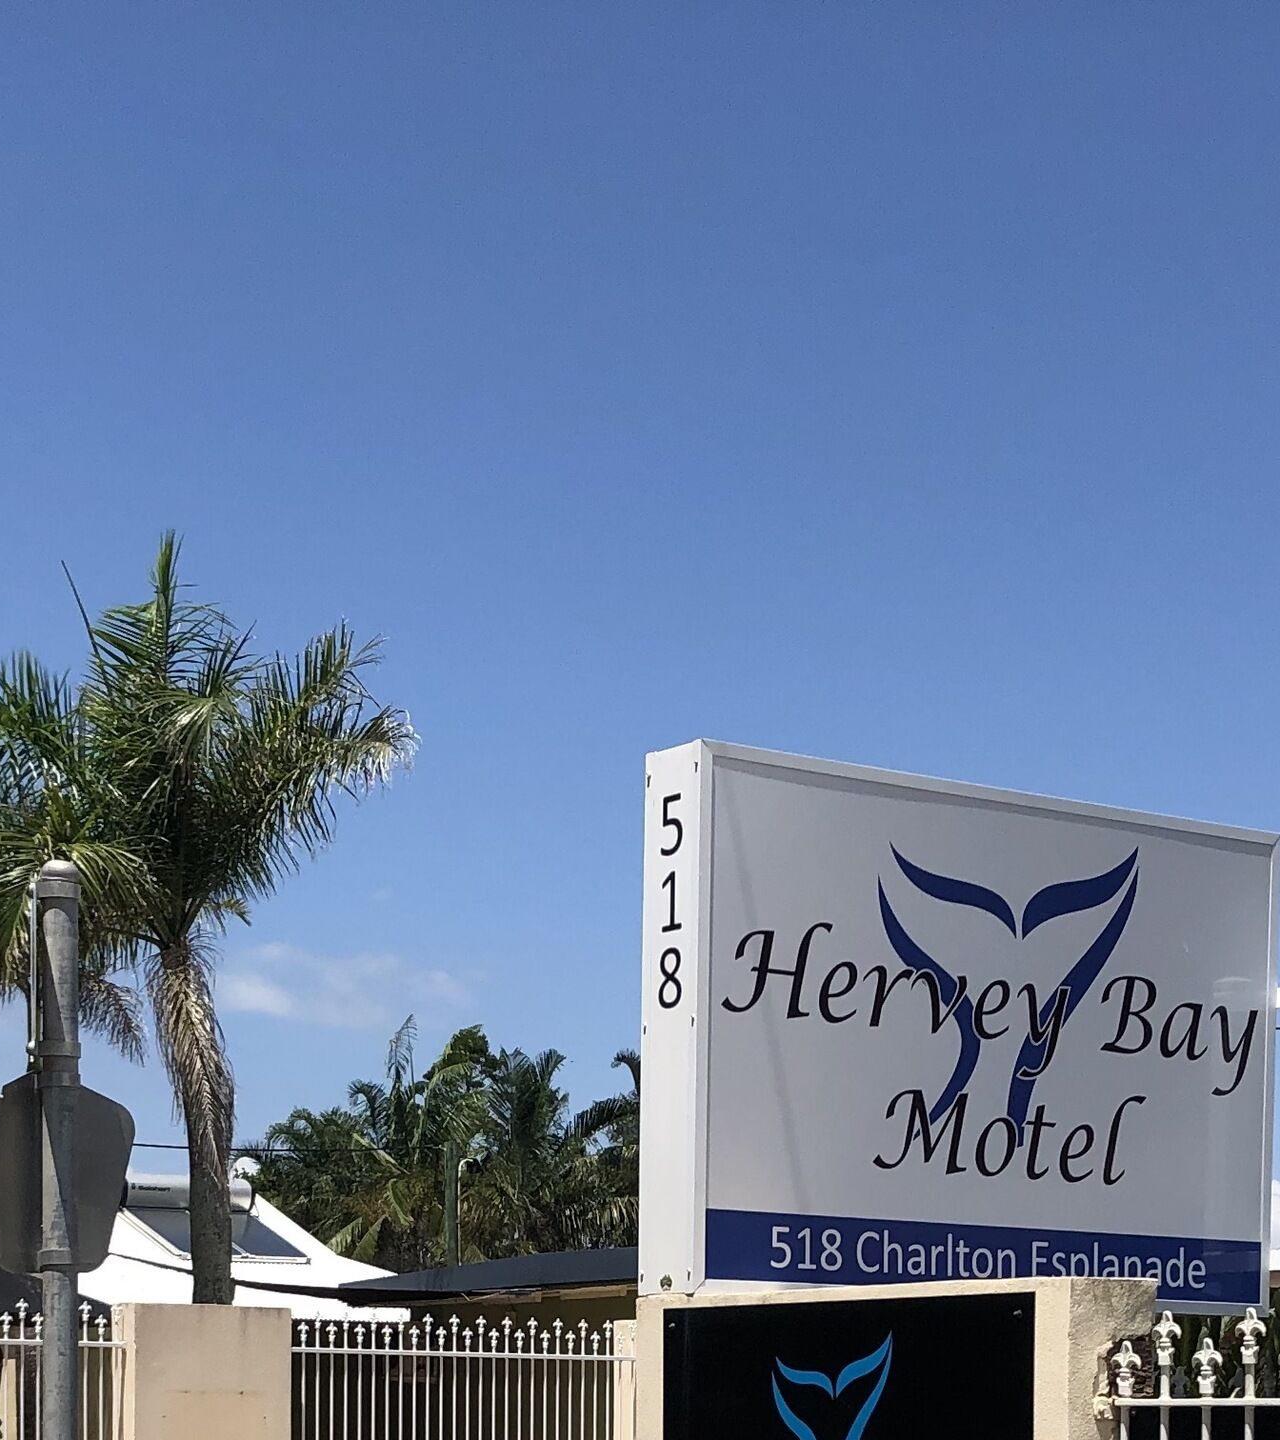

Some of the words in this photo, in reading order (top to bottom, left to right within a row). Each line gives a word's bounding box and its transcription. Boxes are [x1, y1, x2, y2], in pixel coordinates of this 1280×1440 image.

[657, 793, 684, 1010] 518
[721, 922, 1071, 1080] Hervey
[1099, 975, 1258, 1097] Bay
[873, 1089, 1147, 1186] Motel
[769, 1225, 843, 1273] 518
[856, 1230, 1017, 1279] Charlton
[1031, 1240, 1207, 1289] Esplanade
